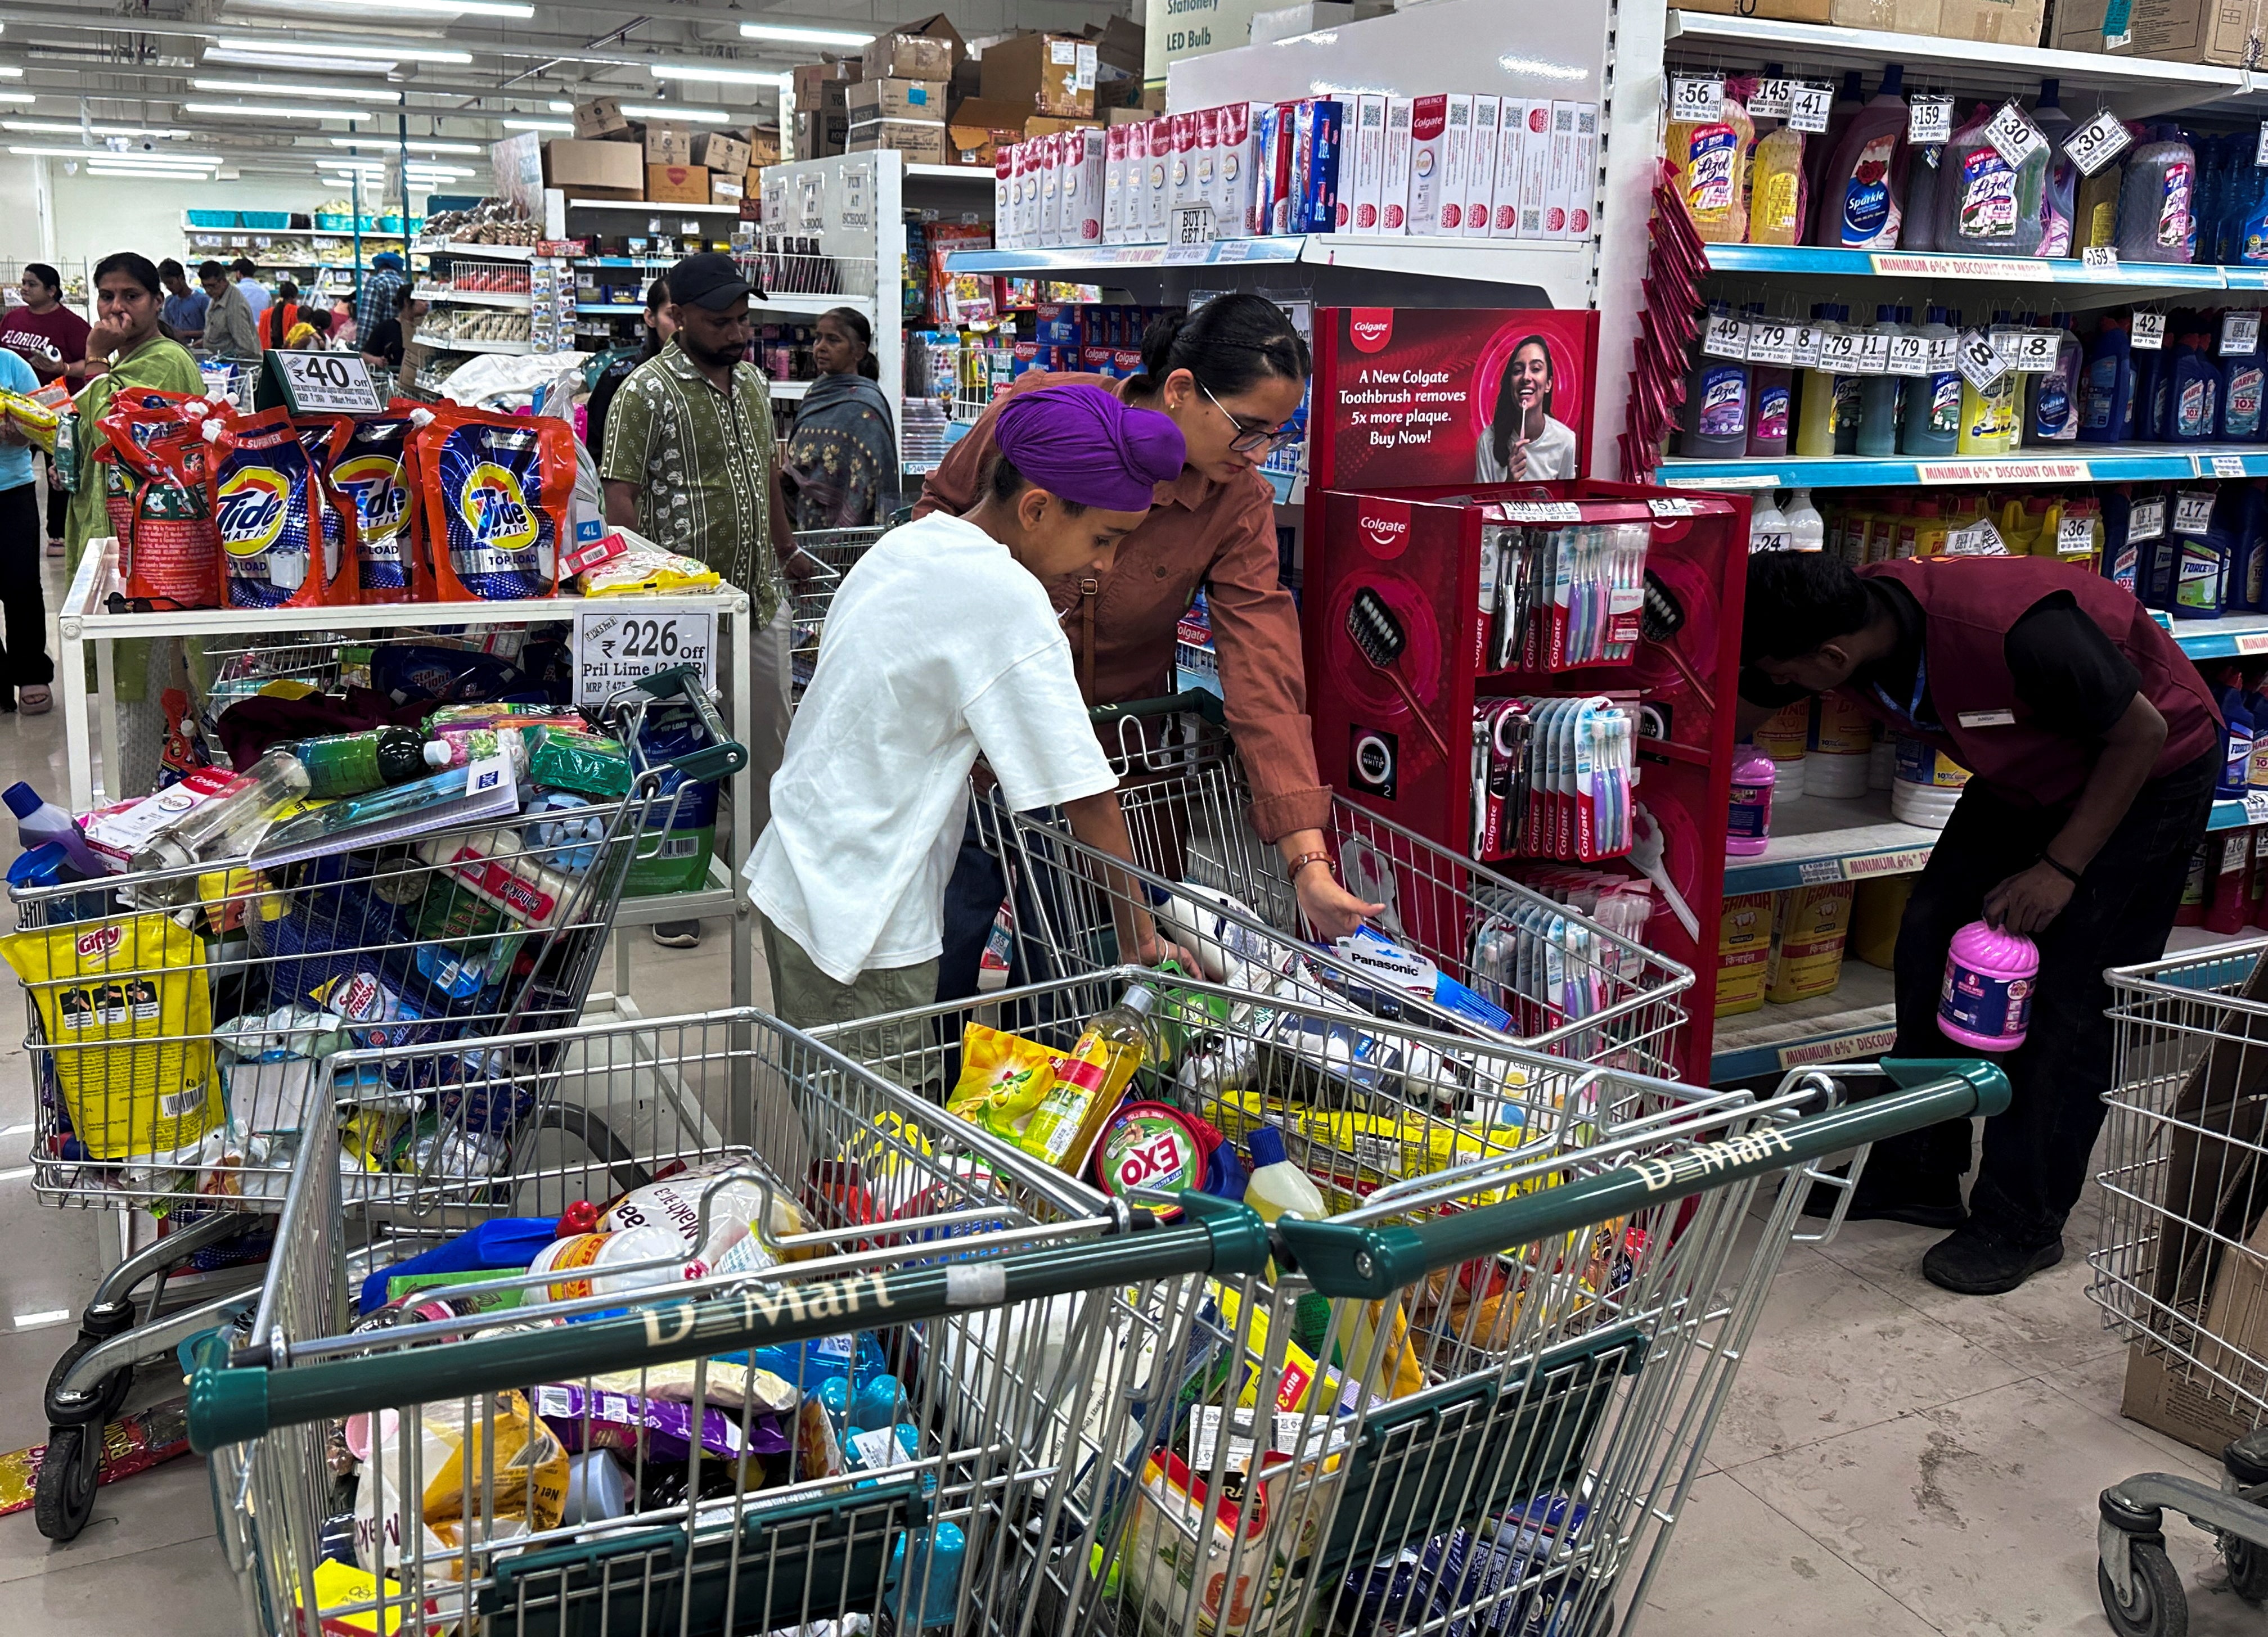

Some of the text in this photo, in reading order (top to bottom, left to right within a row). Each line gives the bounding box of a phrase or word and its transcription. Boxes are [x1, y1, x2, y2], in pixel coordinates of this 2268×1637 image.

[1167, 26, 1211, 51] LED Bulb
[1416, 96, 1443, 106] SAVER PACK
[1413, 115, 1443, 129] Colgate
[1415, 159, 1432, 168] Total
[1698, 155, 1729, 179] Lizol
[1973, 175, 2014, 199] Lizol
[807, 201, 814, 213] AT
[850, 195, 860, 207] AT
[1848, 192, 1885, 210] Sparkle
[771, 207, 778, 218] AT
[842, 213, 868, 226] SCHOOL
[1182, 210, 1208, 227] BUY 1
[765, 222, 788, 235] SCHOOL
[800, 218, 824, 229] SCHOOL
[1181, 227, 1206, 244] GET 1
[1880, 258, 1928, 273] MINIMUM
[1954, 261, 2000, 275] DISCOUNT
[1037, 305, 1059, 315] Colgate
[1354, 322, 1388, 332] Colgate
[1, 330, 51, 349] FLORIDA
[1015, 344, 1037, 356] Colgate
[1085, 348, 1110, 360] Colgate
[1114, 352, 1141, 365] Colgate
[1359, 369, 1449, 387] A New Colgate
[2232, 372, 2259, 389] HARPIC
[1339, 390, 1466, 405] Toothbrush removes
[1711, 383, 1739, 402] Lizol
[1939, 386, 1959, 402] Lizol
[346, 396, 358, 405] Price
[1766, 400, 1785, 416] Lizol
[2040, 398, 2066, 412] Sparkle
[2234, 398, 2255, 409] 10X
[1351, 409, 1452, 427] 5x more plaque.
[2185, 409, 2199, 418] 10X
[238, 438, 244, 447] L
[1369, 430, 1432, 449] Buy Now!
[1925, 466, 1971, 480] MINIMUM
[1997, 466, 2040, 479] DISCOUNT
[2043, 466, 2055, 477] ON
[338, 477, 406, 520] Tide
[216, 490, 284, 532] Tide
[492, 523, 530, 538] MATIC
[583, 525, 597, 536] 4L
[1360, 516, 1407, 534] Colgate
[1984, 529, 1998, 544] BUY
[368, 545, 399, 556] LOAD
[241, 561, 267, 572] LOAD
[488, 554, 537, 566] TOP LOAD
[2116, 551, 2137, 569] HARPIC
[2117, 578, 2133, 590] 10X
[622, 620, 706, 660] 226 Off
[1526, 619, 1537, 668] Colgate
[1551, 617, 1561, 668] Colgate
[412, 669, 436, 683] Star
[583, 663, 650, 677] Pril Lime
[586, 682, 602, 693] MRP
[672, 721, 687, 730] LOAD
[1362, 757, 1384, 769] WHITE
[210, 766, 230, 777] SAVER
[1384, 784, 1391, 797] 2
[155, 796, 190, 809] Total
[1486, 804, 1498, 853] Colgate
[1531, 804, 1541, 853] Colgate
[1545, 804, 1555, 854] Colgate
[1559, 807, 1569, 856] Colgate
[1850, 855, 1895, 874] MINIMUM
[78, 925, 120, 955] Giffy
[1351, 952, 1419, 977] Panasonic
[339, 974, 365, 1007] Sani
[349, 982, 376, 1019] FRESH
[1786, 1044, 1833, 1065] MINIMUM
[1857, 1031, 1897, 1052] DISCOUN
[1154, 1129, 1172, 1142] ROUND
[1277, 1372, 1300, 1408] BUY 3
